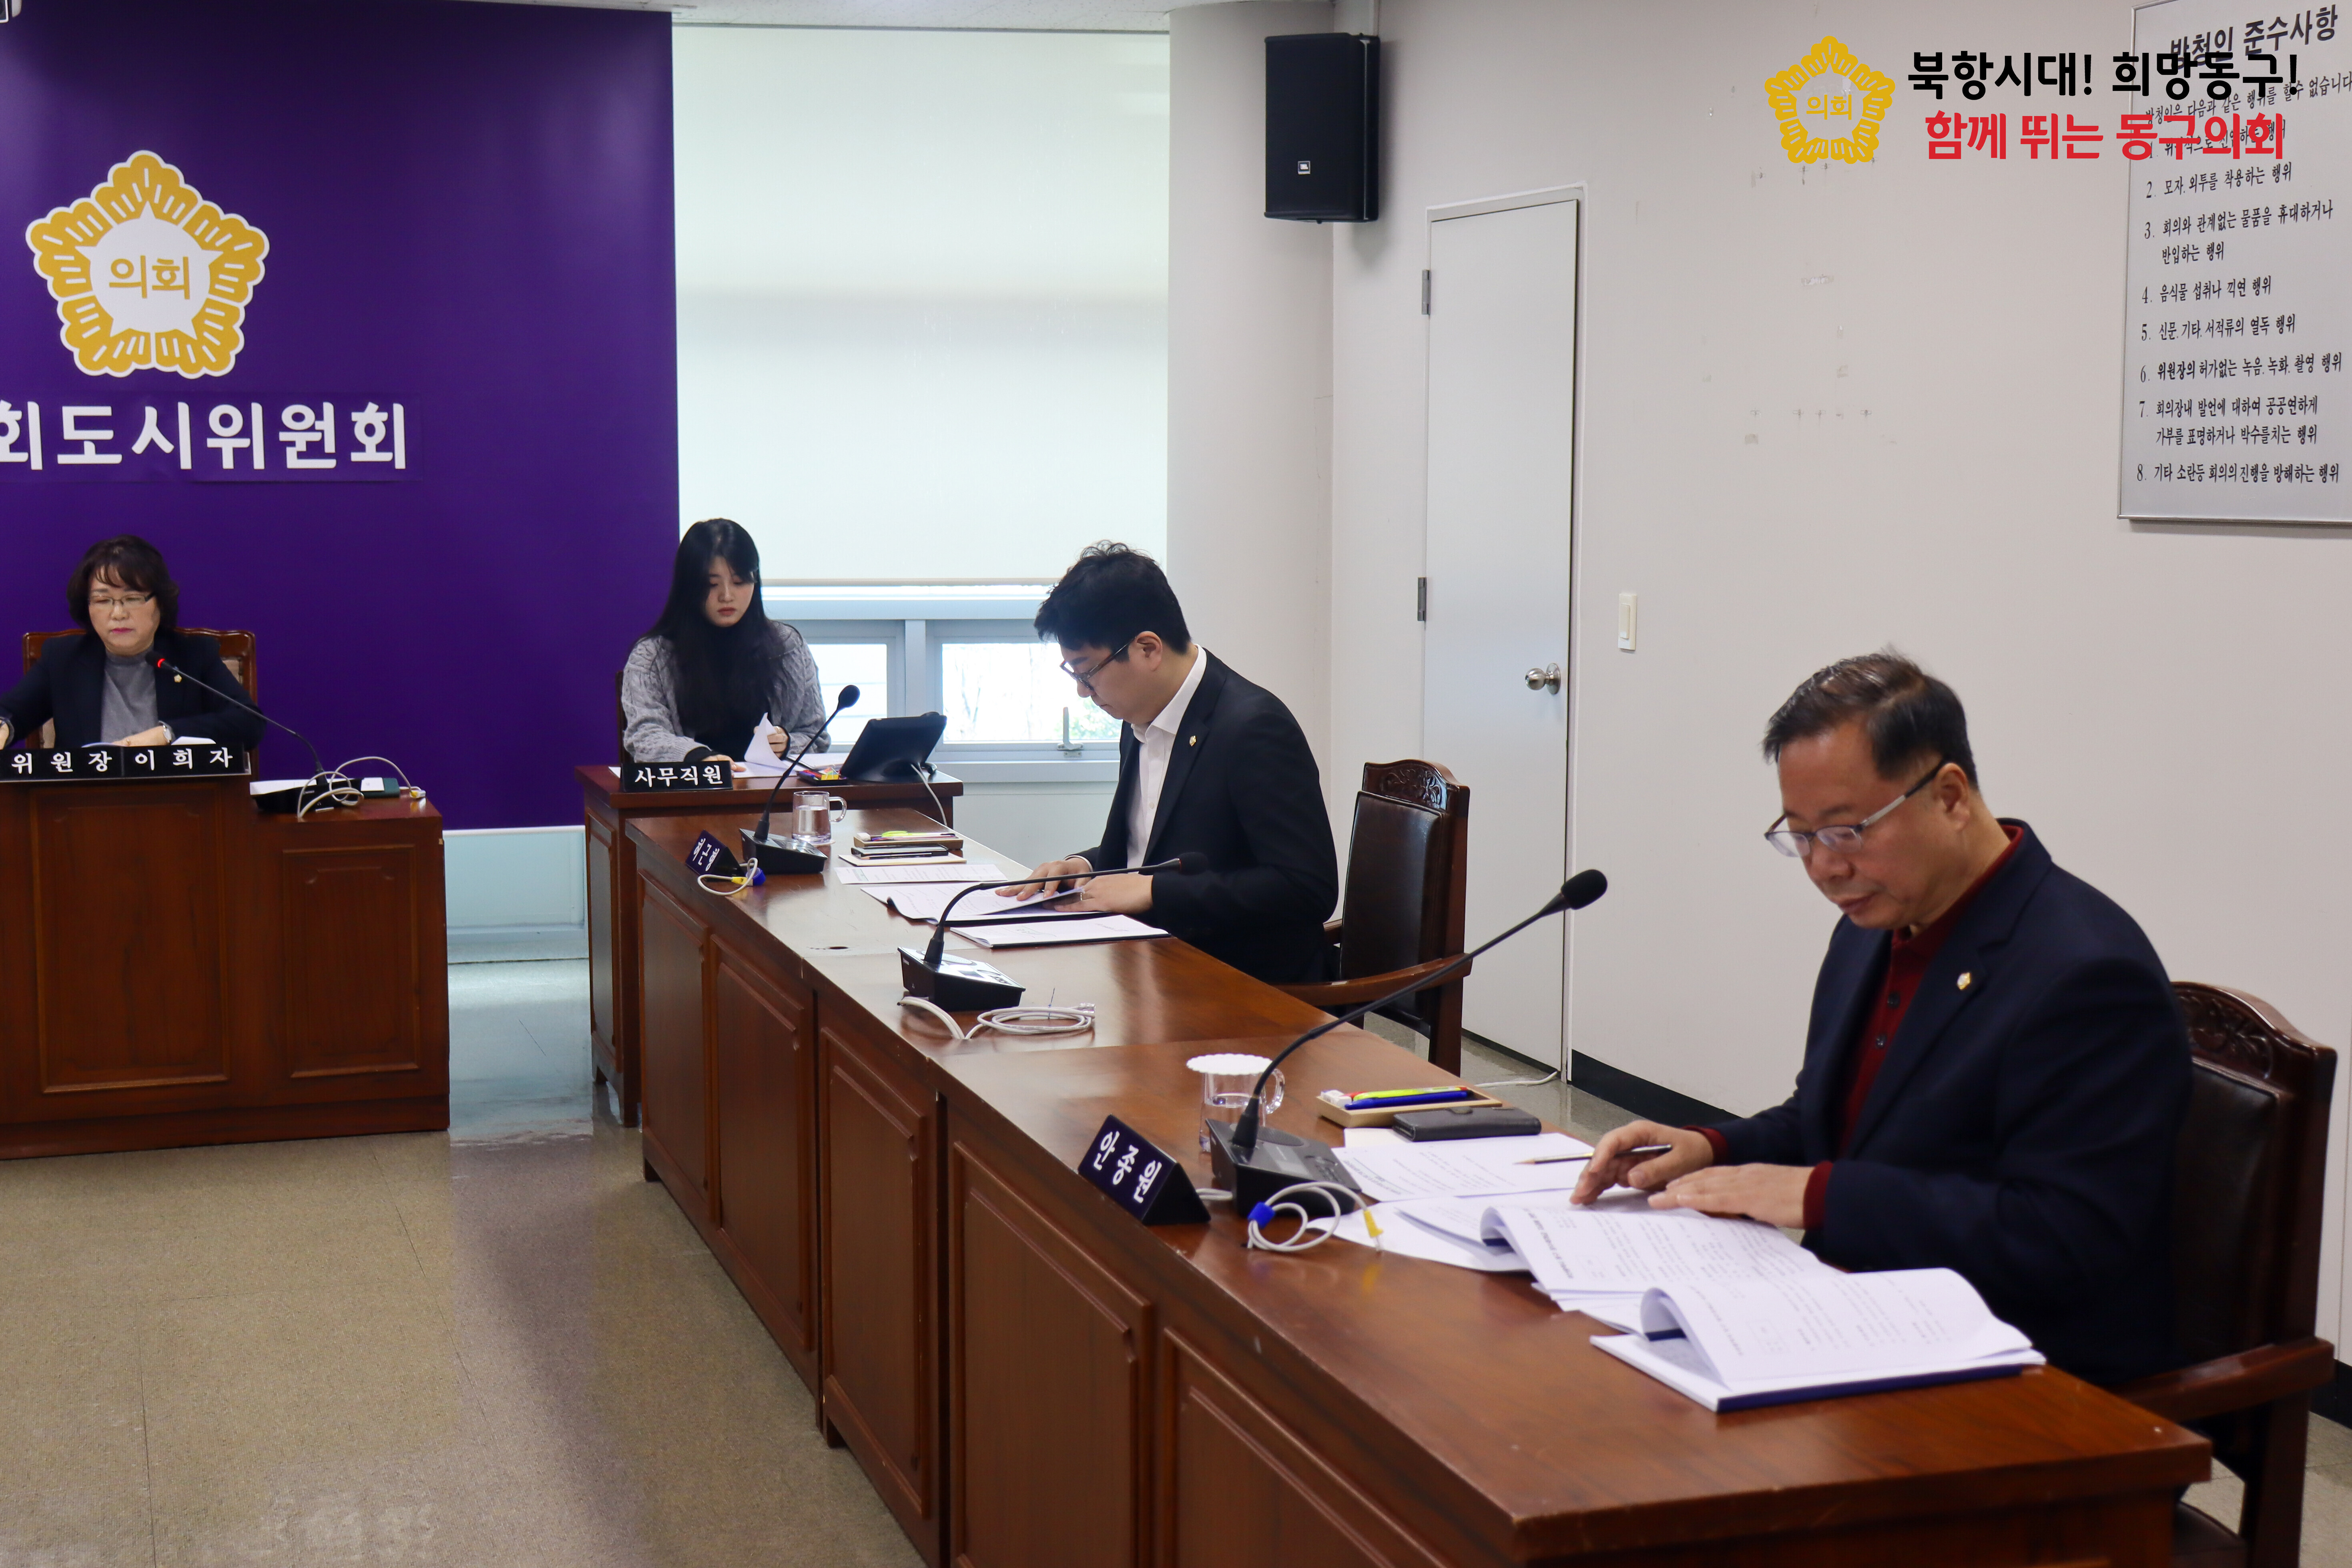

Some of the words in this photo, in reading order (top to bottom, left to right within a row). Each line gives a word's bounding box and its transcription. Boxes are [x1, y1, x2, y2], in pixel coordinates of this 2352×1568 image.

[2171, 26, 2234, 70] 방청인
[2244, 4, 2338, 57] 준수사항
[2187, 98, 2216, 118] 다음과
[2146, 181, 2155, 198] 2.
[2189, 173, 2218, 193] 외투를
[2224, 167, 2265, 189] 착용하는
[2272, 162, 2292, 183] 행위
[2145, 222, 2154, 239] 3.
[2163, 216, 2191, 237] 회의와
[2197, 211, 2236, 233] 관계없는
[2241, 206, 2272, 228] 물품을
[2278, 199, 2333, 224] 휴대하거나
[2162, 244, 2200, 265] 반입하는
[2206, 241, 2224, 261] 행위
[109, 255, 189, 299] 의회
[2142, 287, 2152, 303] 4.
[2160, 283, 2187, 303] 음식물
[2193, 280, 2222, 301] 섭취나
[2227, 278, 2246, 298] 끽연
[2252, 275, 2271, 296] 행위
[2141, 324, 2150, 341] 5.
[2205, 317, 2244, 338] 서적류의
[2251, 316, 2270, 335] 열독
[2276, 313, 2295, 334] 행위
[2141, 365, 2149, 382] 6.
[2157, 360, 2195, 381] 위원장의
[2199, 359, 2237, 378] 허가없는
[2294, 353, 2314, 373] 촬영
[2322, 352, 2341, 373] 행위
[2139, 401, 2148, 418] 7.
[2156, 399, 2192, 418] 회의장내
[2198, 398, 2225, 417] 발언에
[2232, 397, 2260, 416] 대하여
[2266, 395, 2317, 415] 공공연하게
[2156, 427, 2183, 446] 가부를
[2187, 426, 2235, 446] 표명하거나
[2241, 425, 2291, 445] 박수를치는
[2298, 424, 2317, 445] 행위
[2137, 464, 2146, 481] 8.
[2154, 463, 2173, 482] 기타
[2177, 463, 2205, 482] 소란등
[2209, 463, 2237, 483] 회의의
[2240, 463, 2269, 483] 진행을
[2274, 464, 2314, 484] 방해하는
[2319, 463, 2339, 483] 행위
[635, 765, 723, 787] 사무직원
[1094, 1131, 1162, 1203] 안종원
